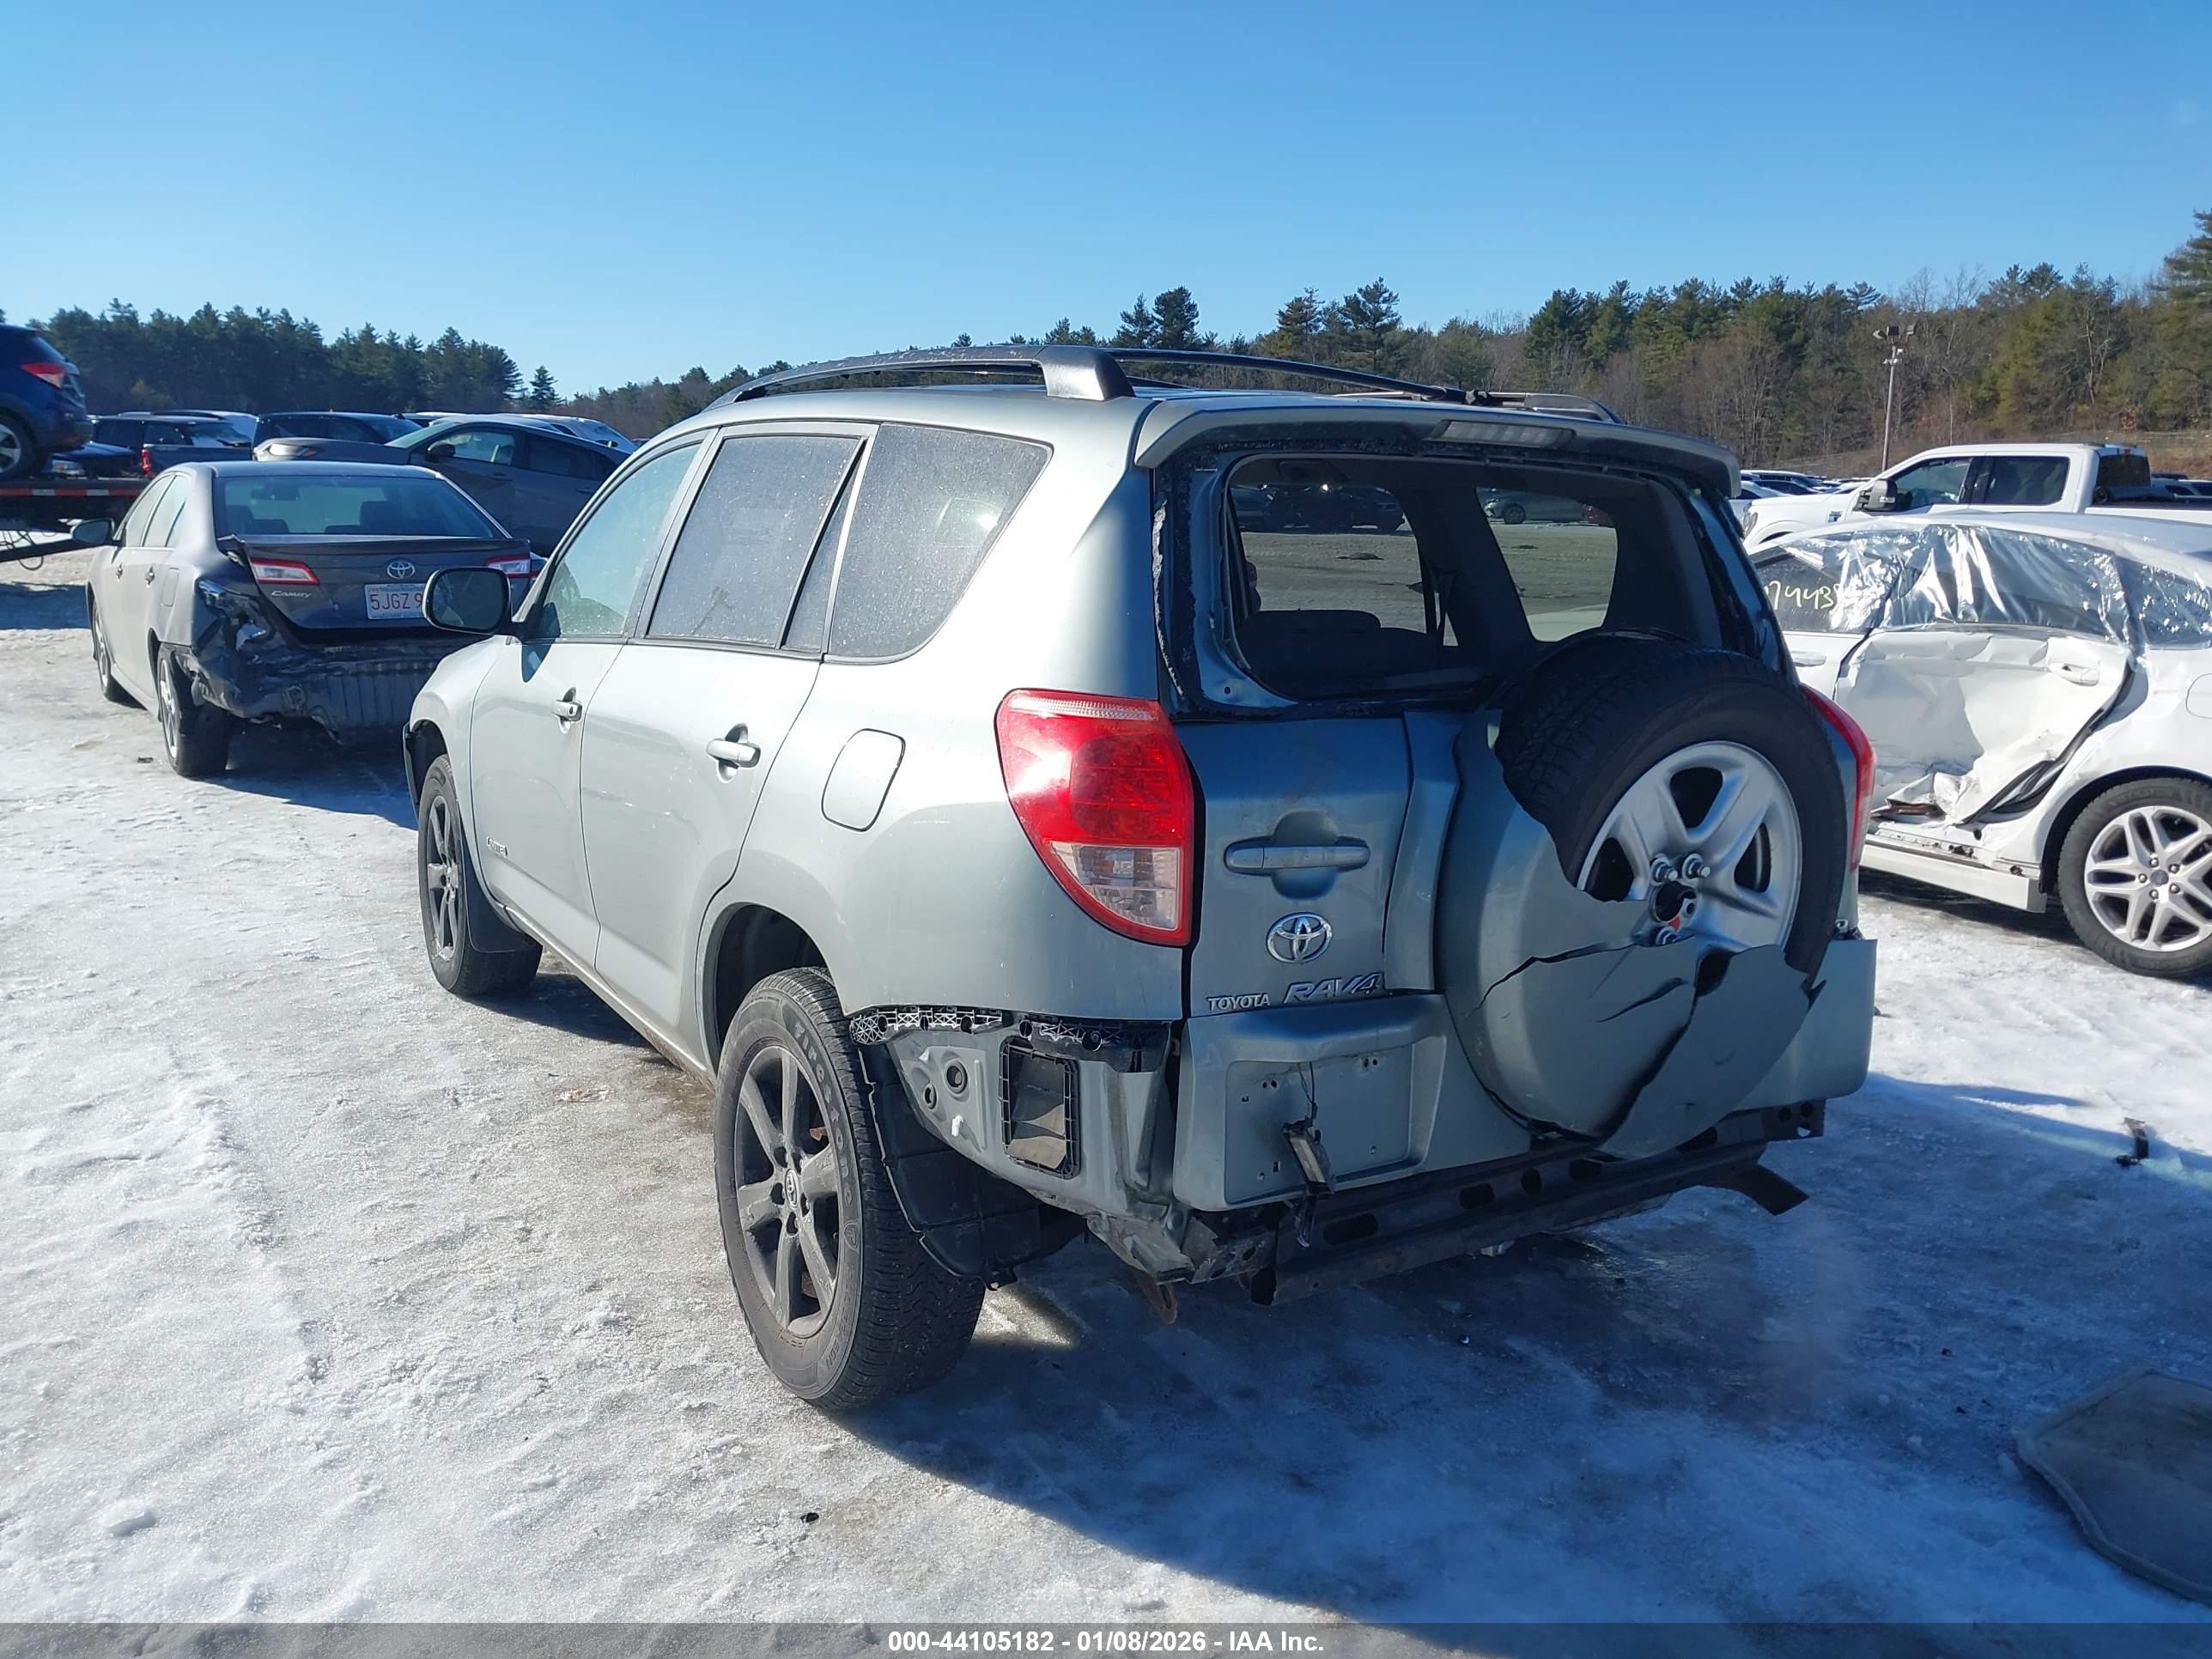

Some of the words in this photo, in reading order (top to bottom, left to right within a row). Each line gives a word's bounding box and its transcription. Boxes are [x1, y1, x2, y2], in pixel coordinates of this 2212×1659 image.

[370, 593, 410, 611] 5JGZ
[1207, 993, 1271, 1012] TOYOTA
[1283, 971, 1386, 1005] RAV4
